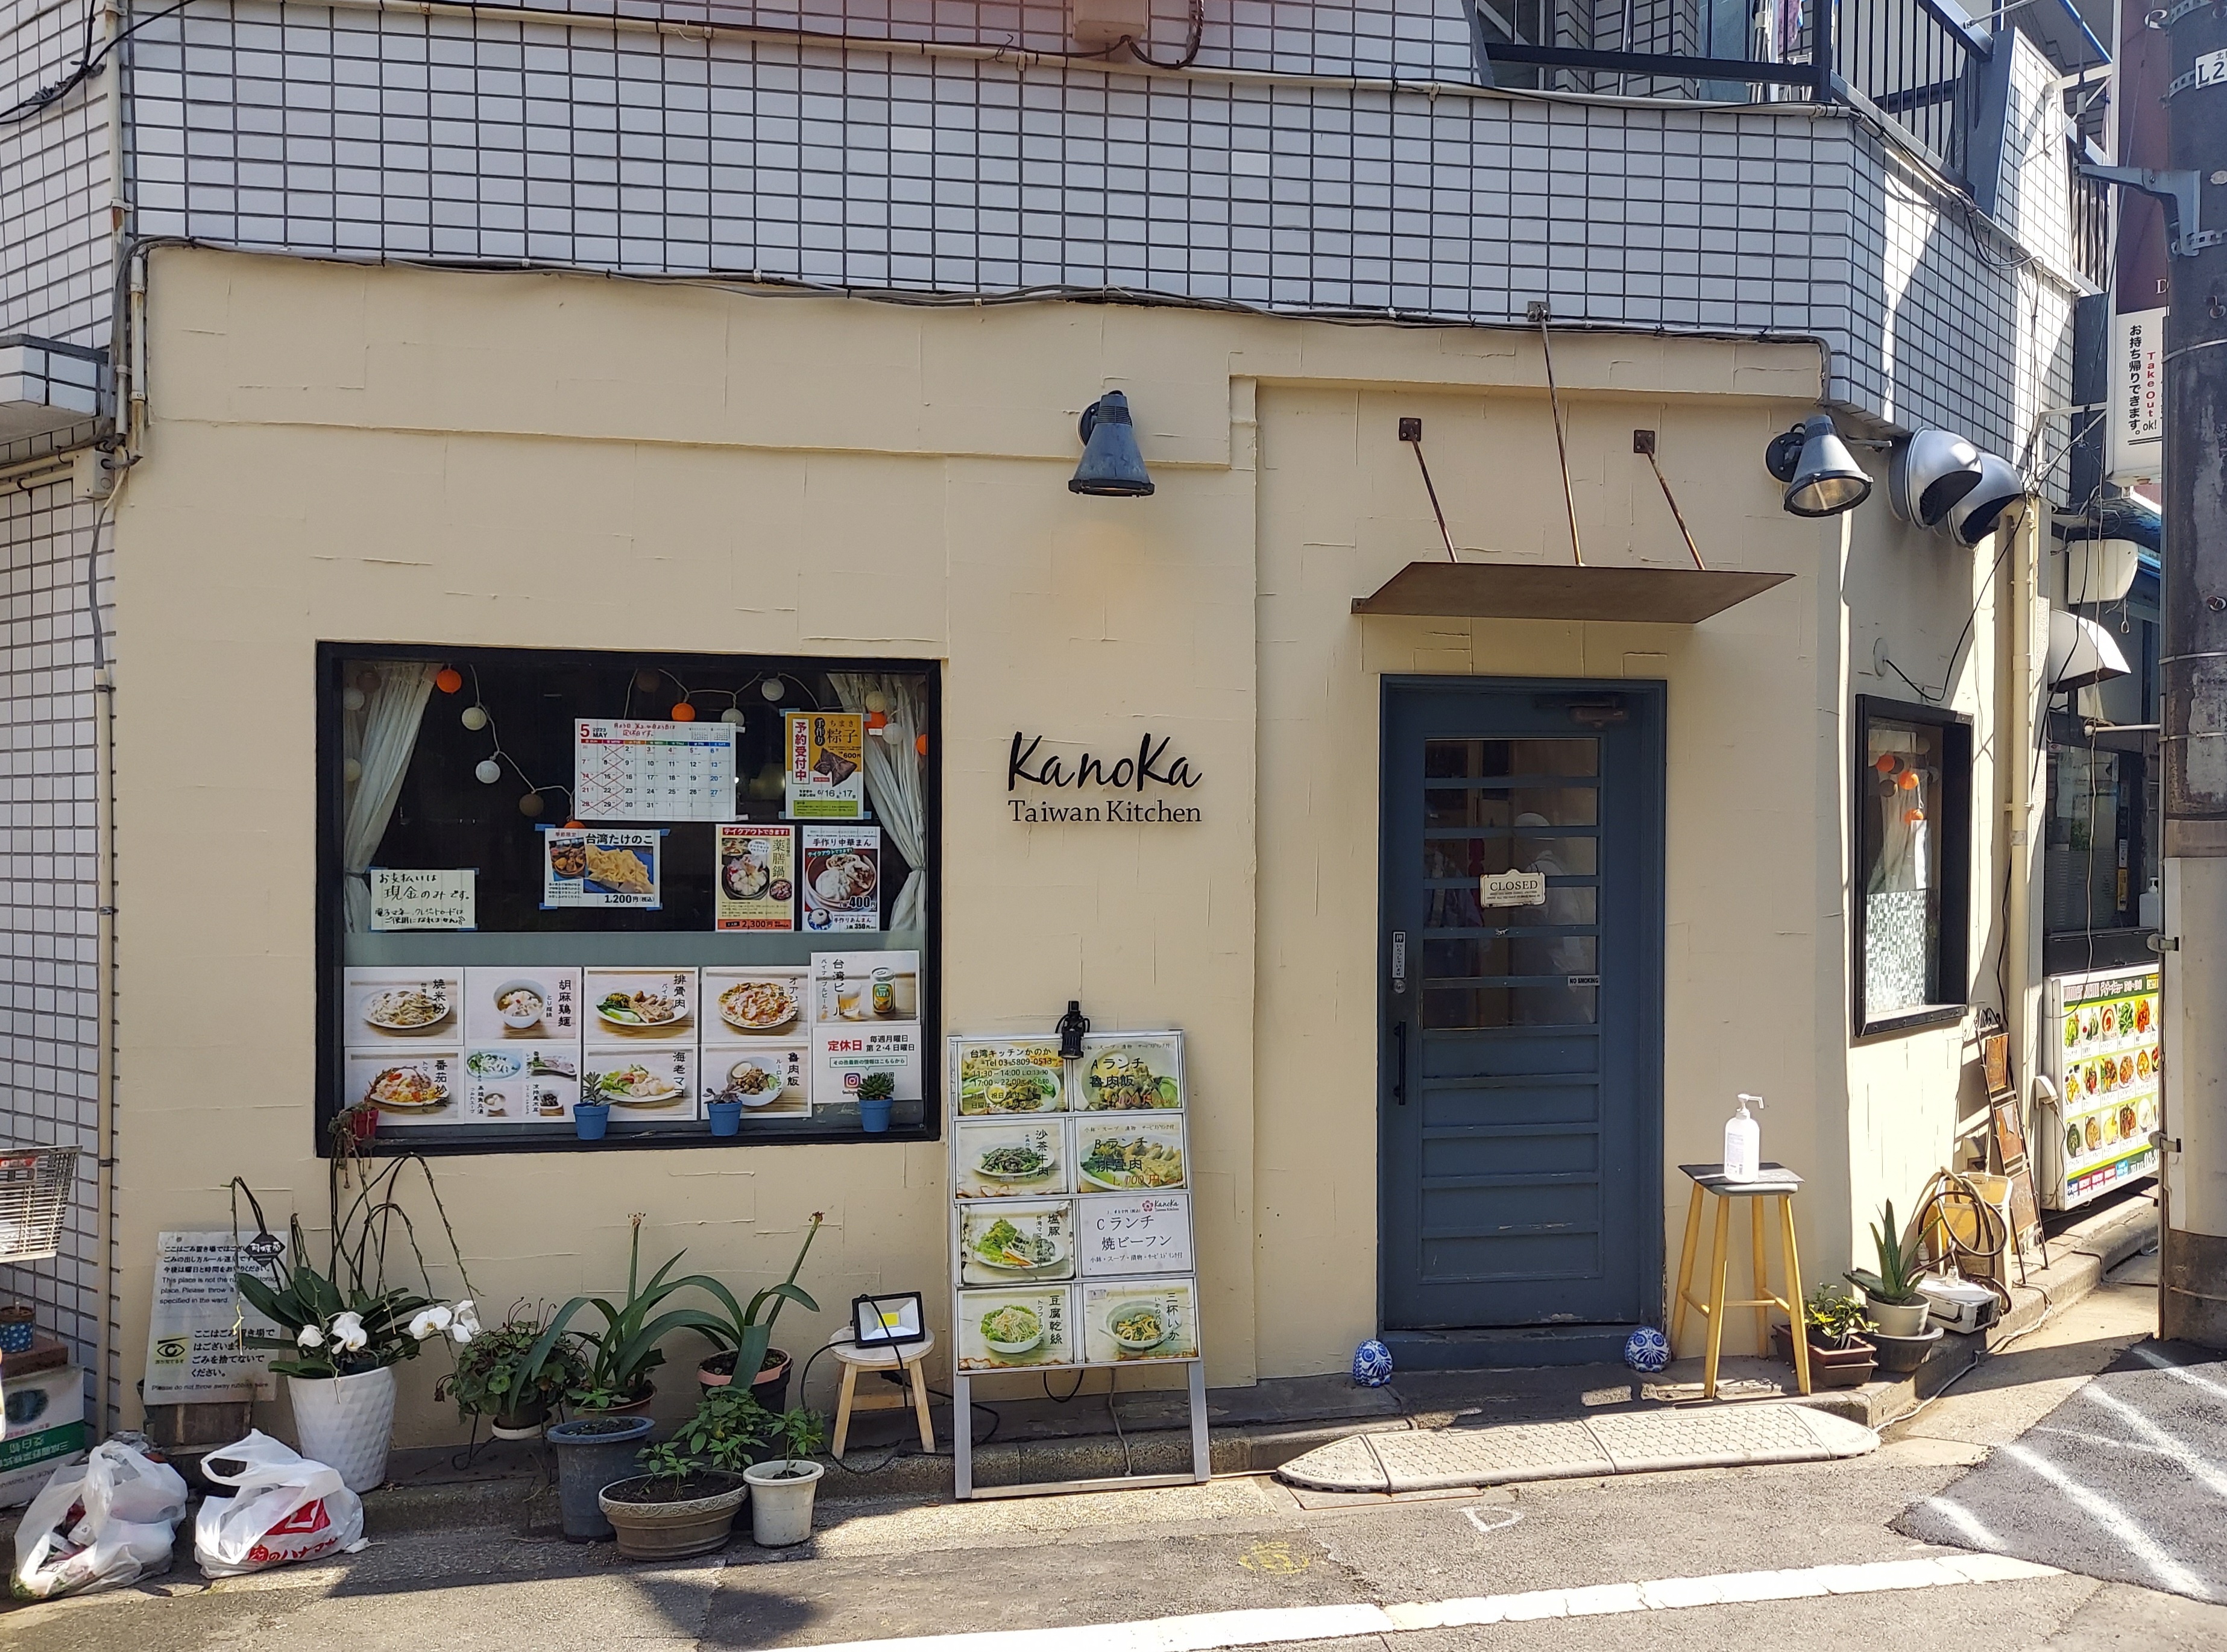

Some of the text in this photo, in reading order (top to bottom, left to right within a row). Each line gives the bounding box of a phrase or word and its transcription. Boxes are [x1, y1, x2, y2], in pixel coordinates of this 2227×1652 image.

[2129, 324, 2142, 435] お持ち帰りできます。
[580, 724, 590, 737] 5
[795, 722, 807, 781] 予約受付中
[1008, 731, 1203, 792] KanoKa
[1007, 799, 1202, 822] Taiwan Kitchen
[585, 833, 653, 844] 台湾たけのこ
[813, 838, 872, 846] 手作り中華まん
[772, 839, 786, 878] 薬膳鍋
[380, 872, 437, 883] お支払いは
[1490, 880, 1538, 891] CLOSED
[742, 920, 772, 929] 2,300円
[673, 974, 687, 1009] 排骨肉
[833, 959, 845, 1016] 台湾ビール
[828, 1039, 862, 1051] 定休日
[971, 1048, 1051, 1059] 台湾キッチンかのか
[673, 1051, 685, 1097] 海老マヨ
[787, 1051, 799, 1086] 魯肉飯
[1035, 1129, 1049, 1176] 沙茶牛肉
[1096, 1158, 1143, 1173] 排骨肉
[1047, 1213, 1061, 1237] 塩豚
[1101, 1235, 1172, 1251] 焼ビーフン
[1166, 1292, 1180, 1341] 三杯いか
[192, 1355, 265, 1364] ごみを捨てないで
[191, 1368, 226, 1378] ください。
